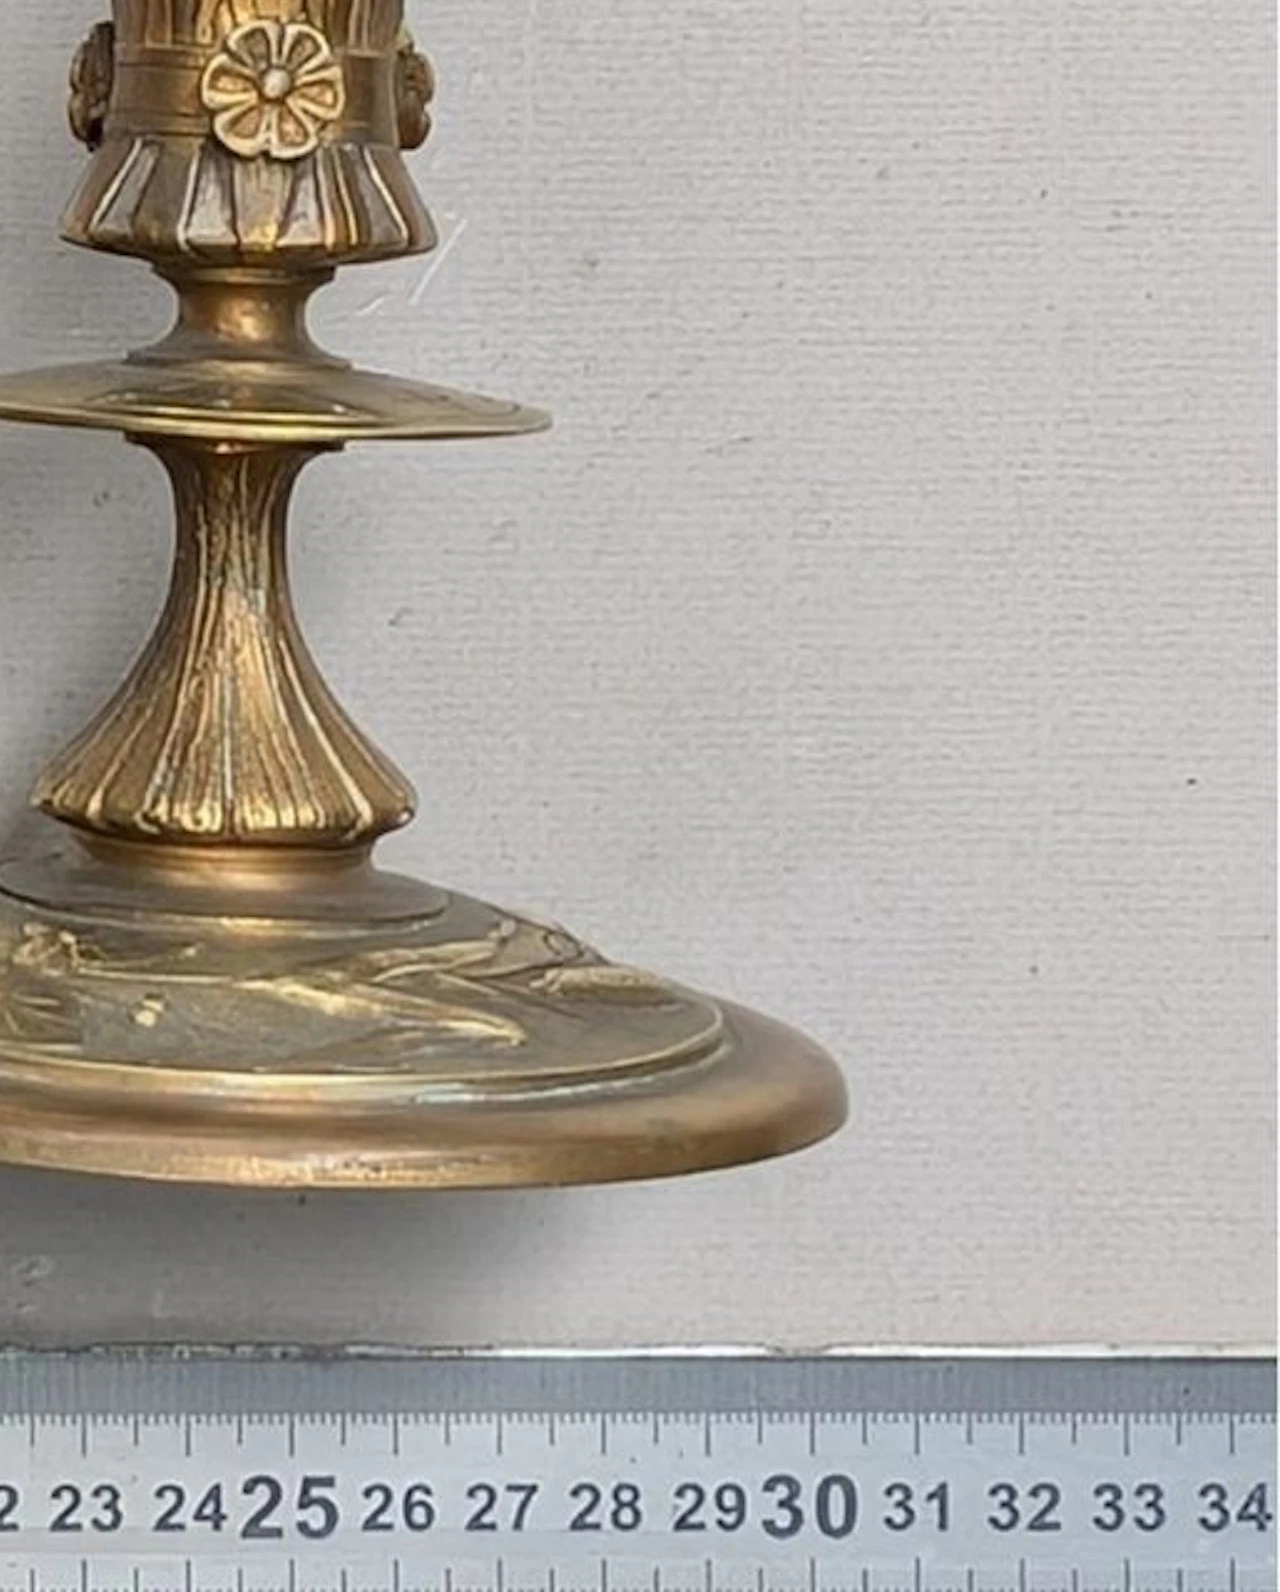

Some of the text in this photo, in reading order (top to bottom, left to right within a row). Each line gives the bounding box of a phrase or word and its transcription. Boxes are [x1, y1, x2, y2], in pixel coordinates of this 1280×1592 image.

[48, 1483, 124, 1533] 23
[151, 1481, 230, 1533] 24
[239, 1473, 340, 1541] 25
[360, 1481, 436, 1533] 26
[464, 1481, 540, 1533] 27
[568, 1481, 643, 1533] 28
[672, 1481, 748, 1533] 29
[760, 1473, 859, 1541] 30
[882, 1480, 949, 1533] 31
[986, 1481, 1062, 1533] 32
[1091, 1482, 1167, 1533] 33
[1197, 1481, 1275, 1534] 34
